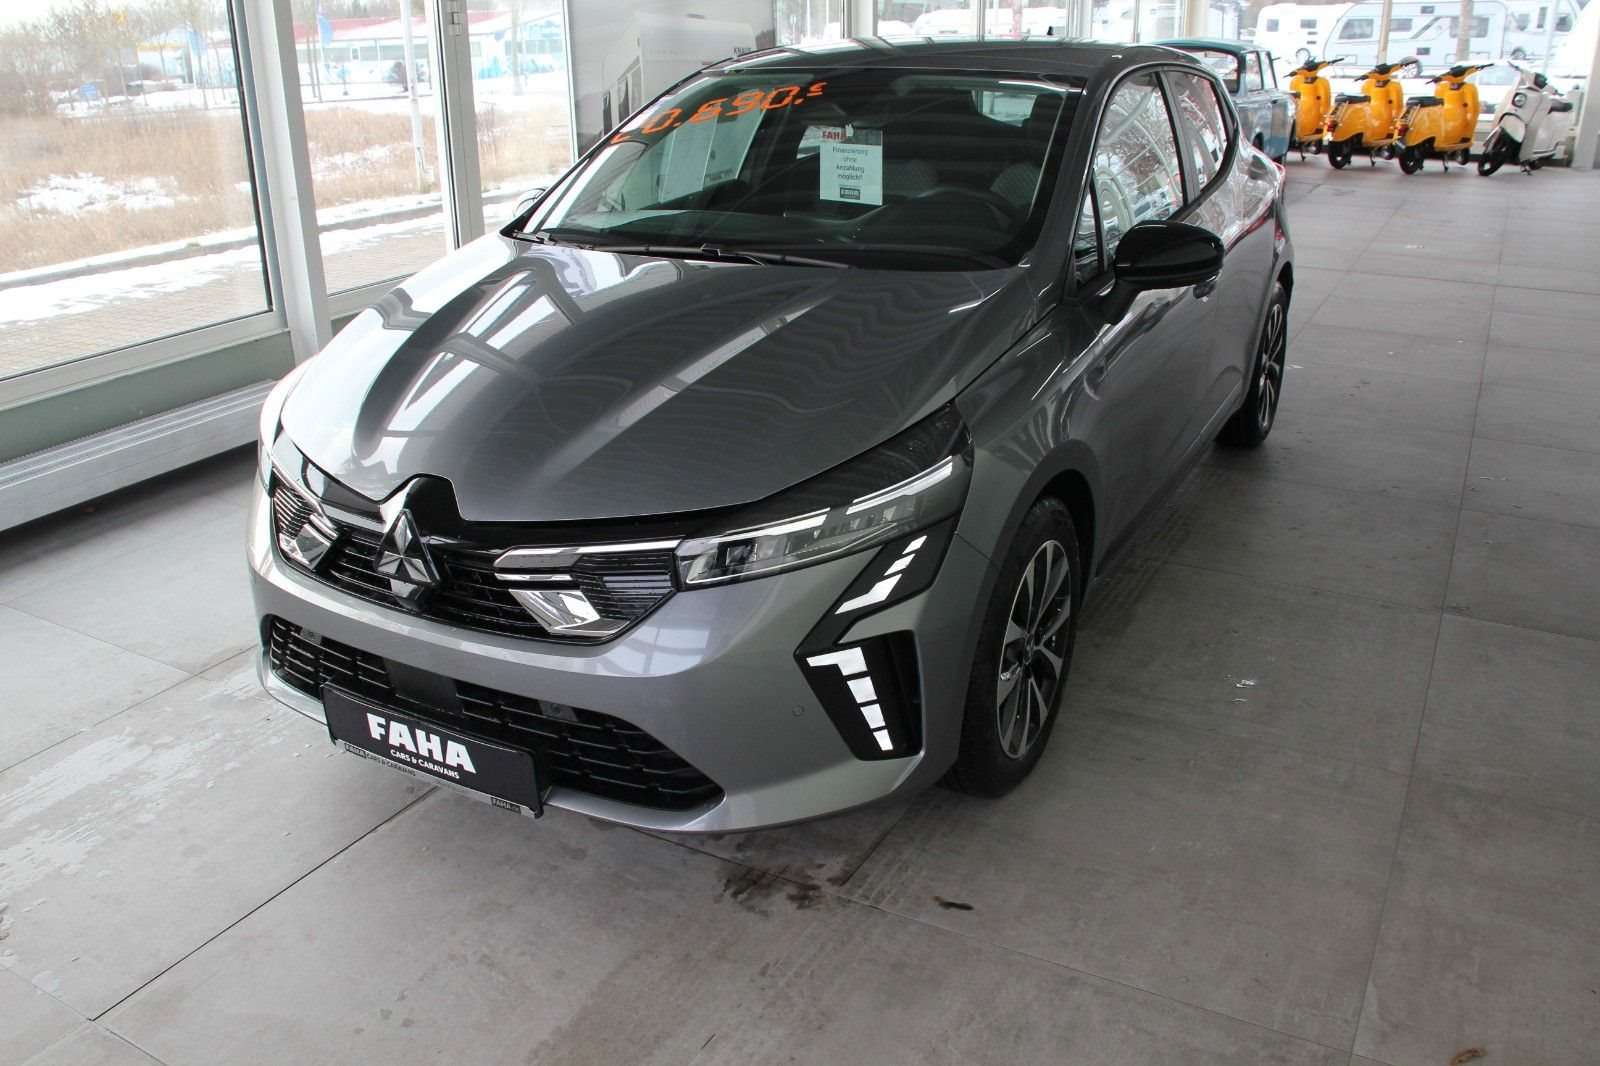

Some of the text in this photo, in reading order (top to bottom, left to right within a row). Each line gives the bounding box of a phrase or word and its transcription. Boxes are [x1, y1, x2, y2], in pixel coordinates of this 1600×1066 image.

[366, 713, 477, 774] FAHA
[390, 748, 411, 763] CARS
[418, 759, 461, 780] CARAVANS
